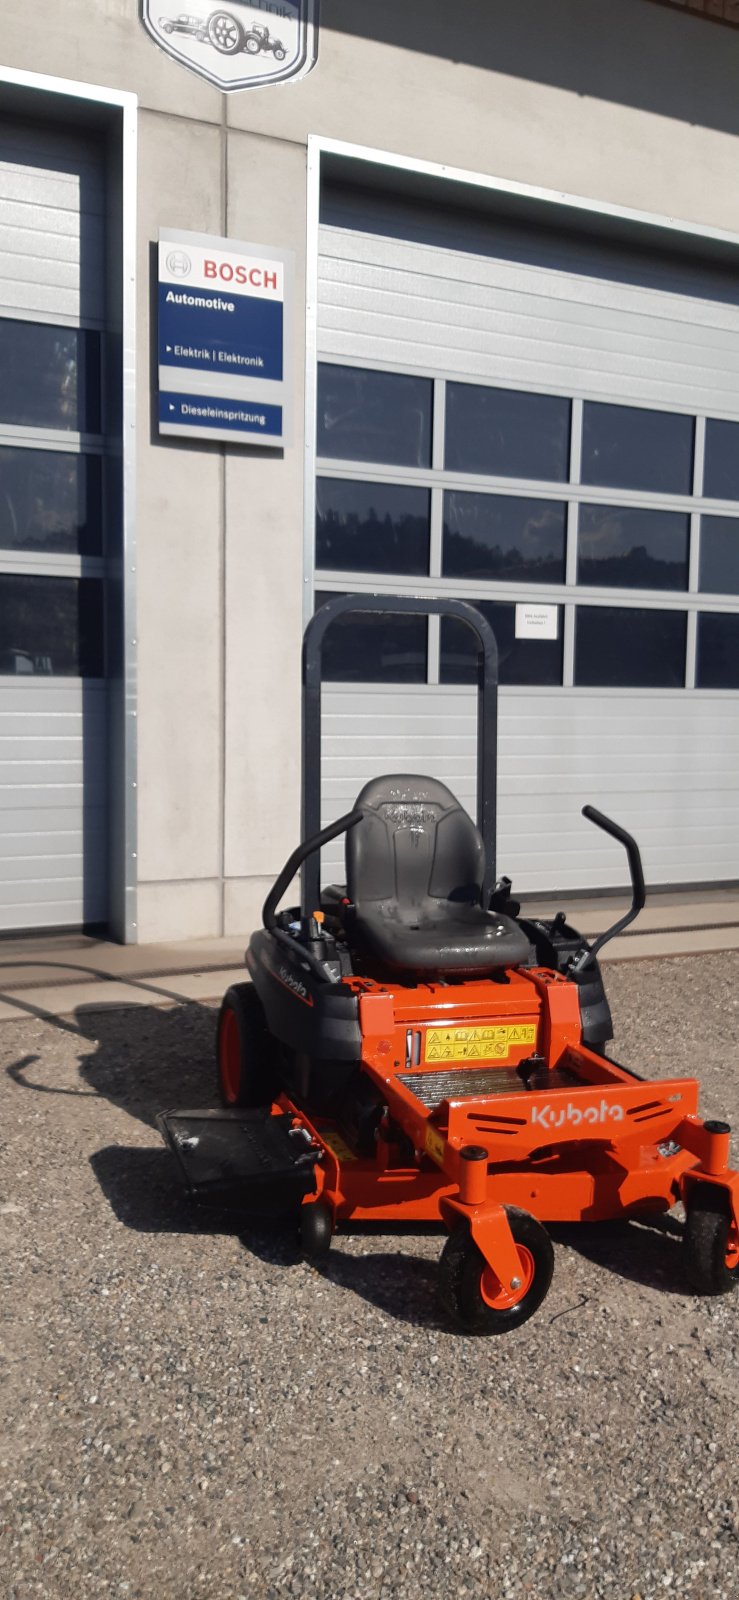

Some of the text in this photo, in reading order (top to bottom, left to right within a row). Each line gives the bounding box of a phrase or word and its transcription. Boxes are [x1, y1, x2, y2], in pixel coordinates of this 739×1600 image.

[203, 260, 277, 289] BOSCH
[166, 291, 235, 312] Automotive
[174, 345, 211, 360] Elektrik
[218, 351, 264, 367] Elektronik
[181, 403, 266, 425] Dieseleinspritzung
[531, 1099, 623, 1128] Kubota
